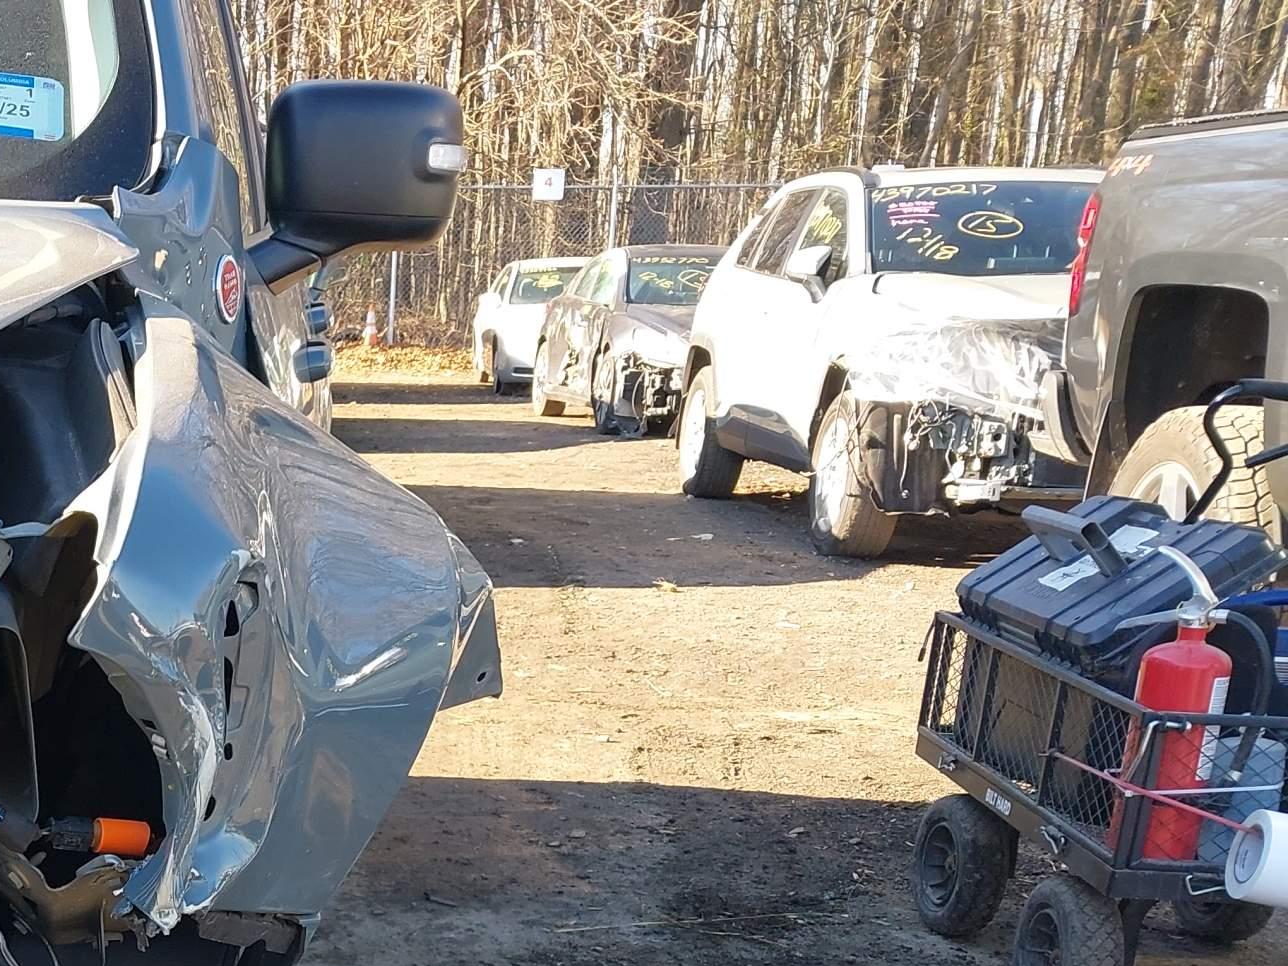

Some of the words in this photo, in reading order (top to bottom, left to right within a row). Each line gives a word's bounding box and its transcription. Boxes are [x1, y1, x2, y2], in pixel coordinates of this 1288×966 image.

[25, 88, 33, 98] 1
[544, 176, 553, 187] 4
[871, 182, 998, 205] 43970217
